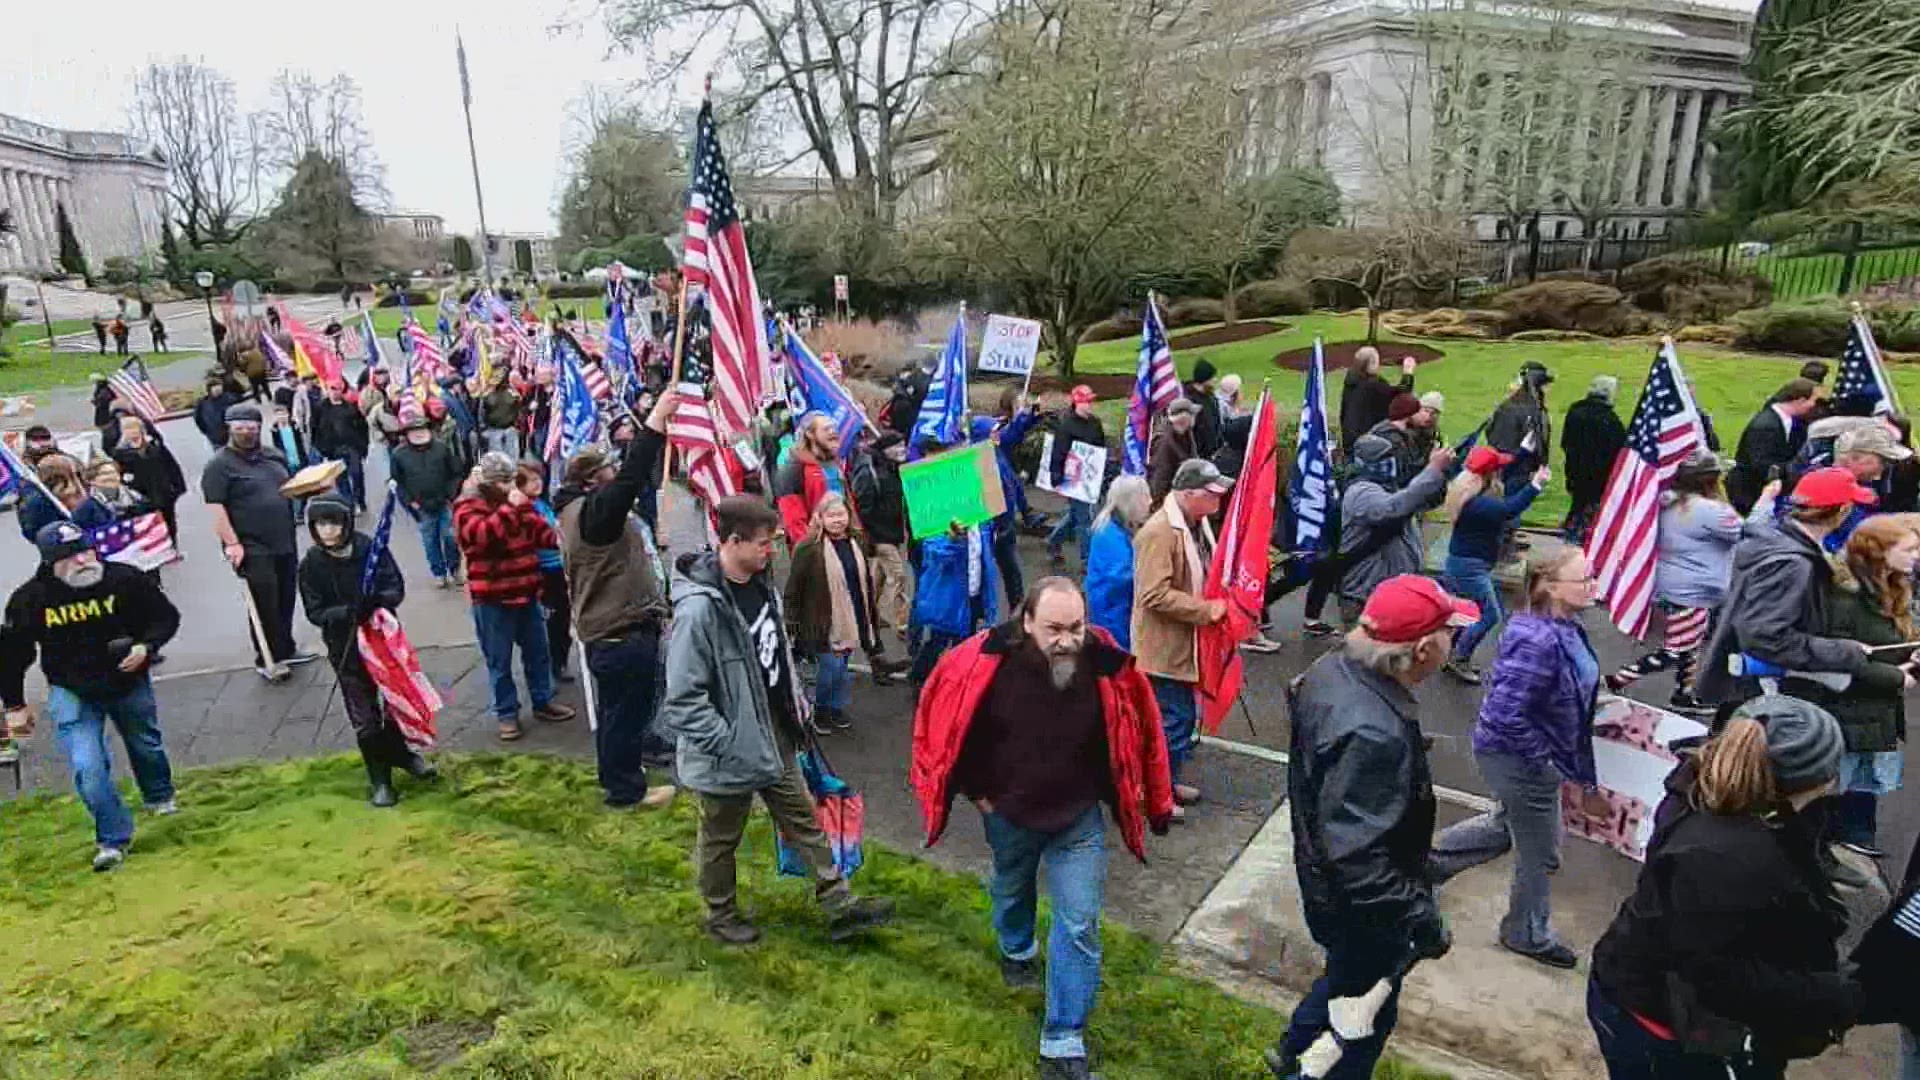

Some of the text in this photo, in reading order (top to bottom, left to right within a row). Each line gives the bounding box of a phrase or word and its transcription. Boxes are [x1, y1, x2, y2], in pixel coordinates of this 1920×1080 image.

[997, 322, 1034, 337] STOP
[985, 348, 1028, 369] STEAL
[44, 594, 115, 628] ARMY
